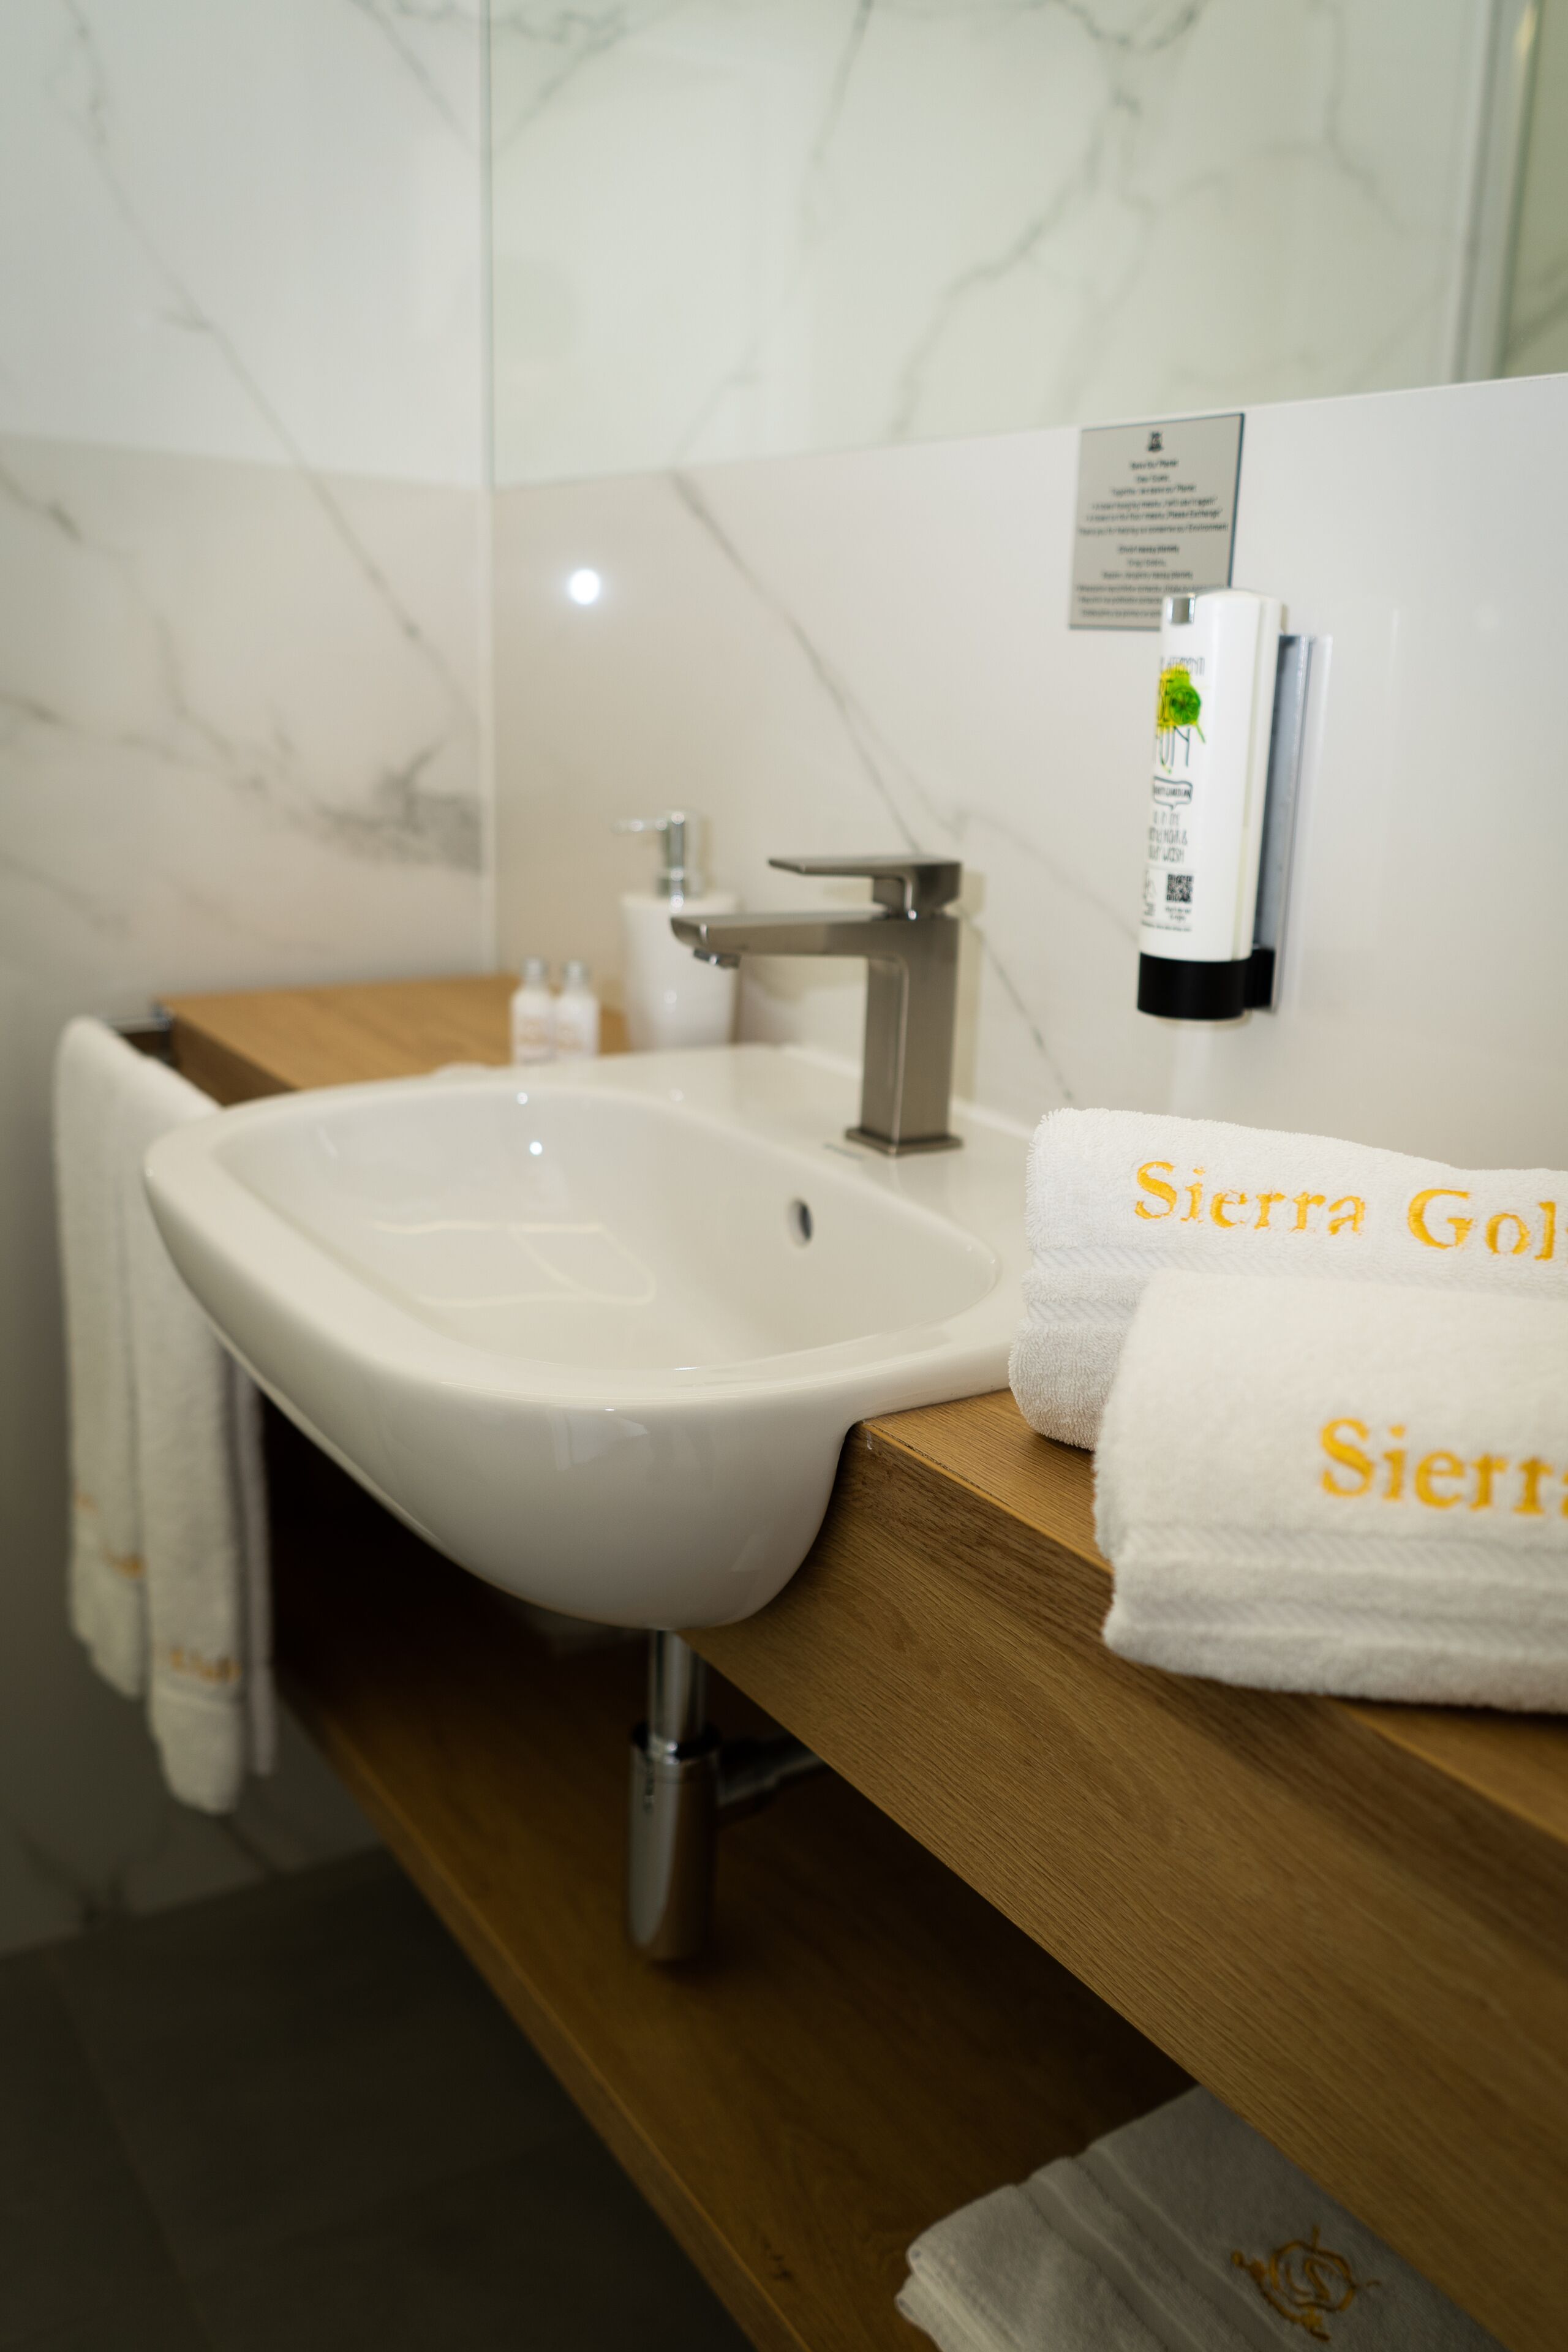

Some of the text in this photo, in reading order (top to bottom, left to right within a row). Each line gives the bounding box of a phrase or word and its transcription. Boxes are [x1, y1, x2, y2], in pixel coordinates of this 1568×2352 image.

[1134, 1161, 1568, 1261] Sierra Gol
[1320, 1417, 1568, 1518] Sierr
